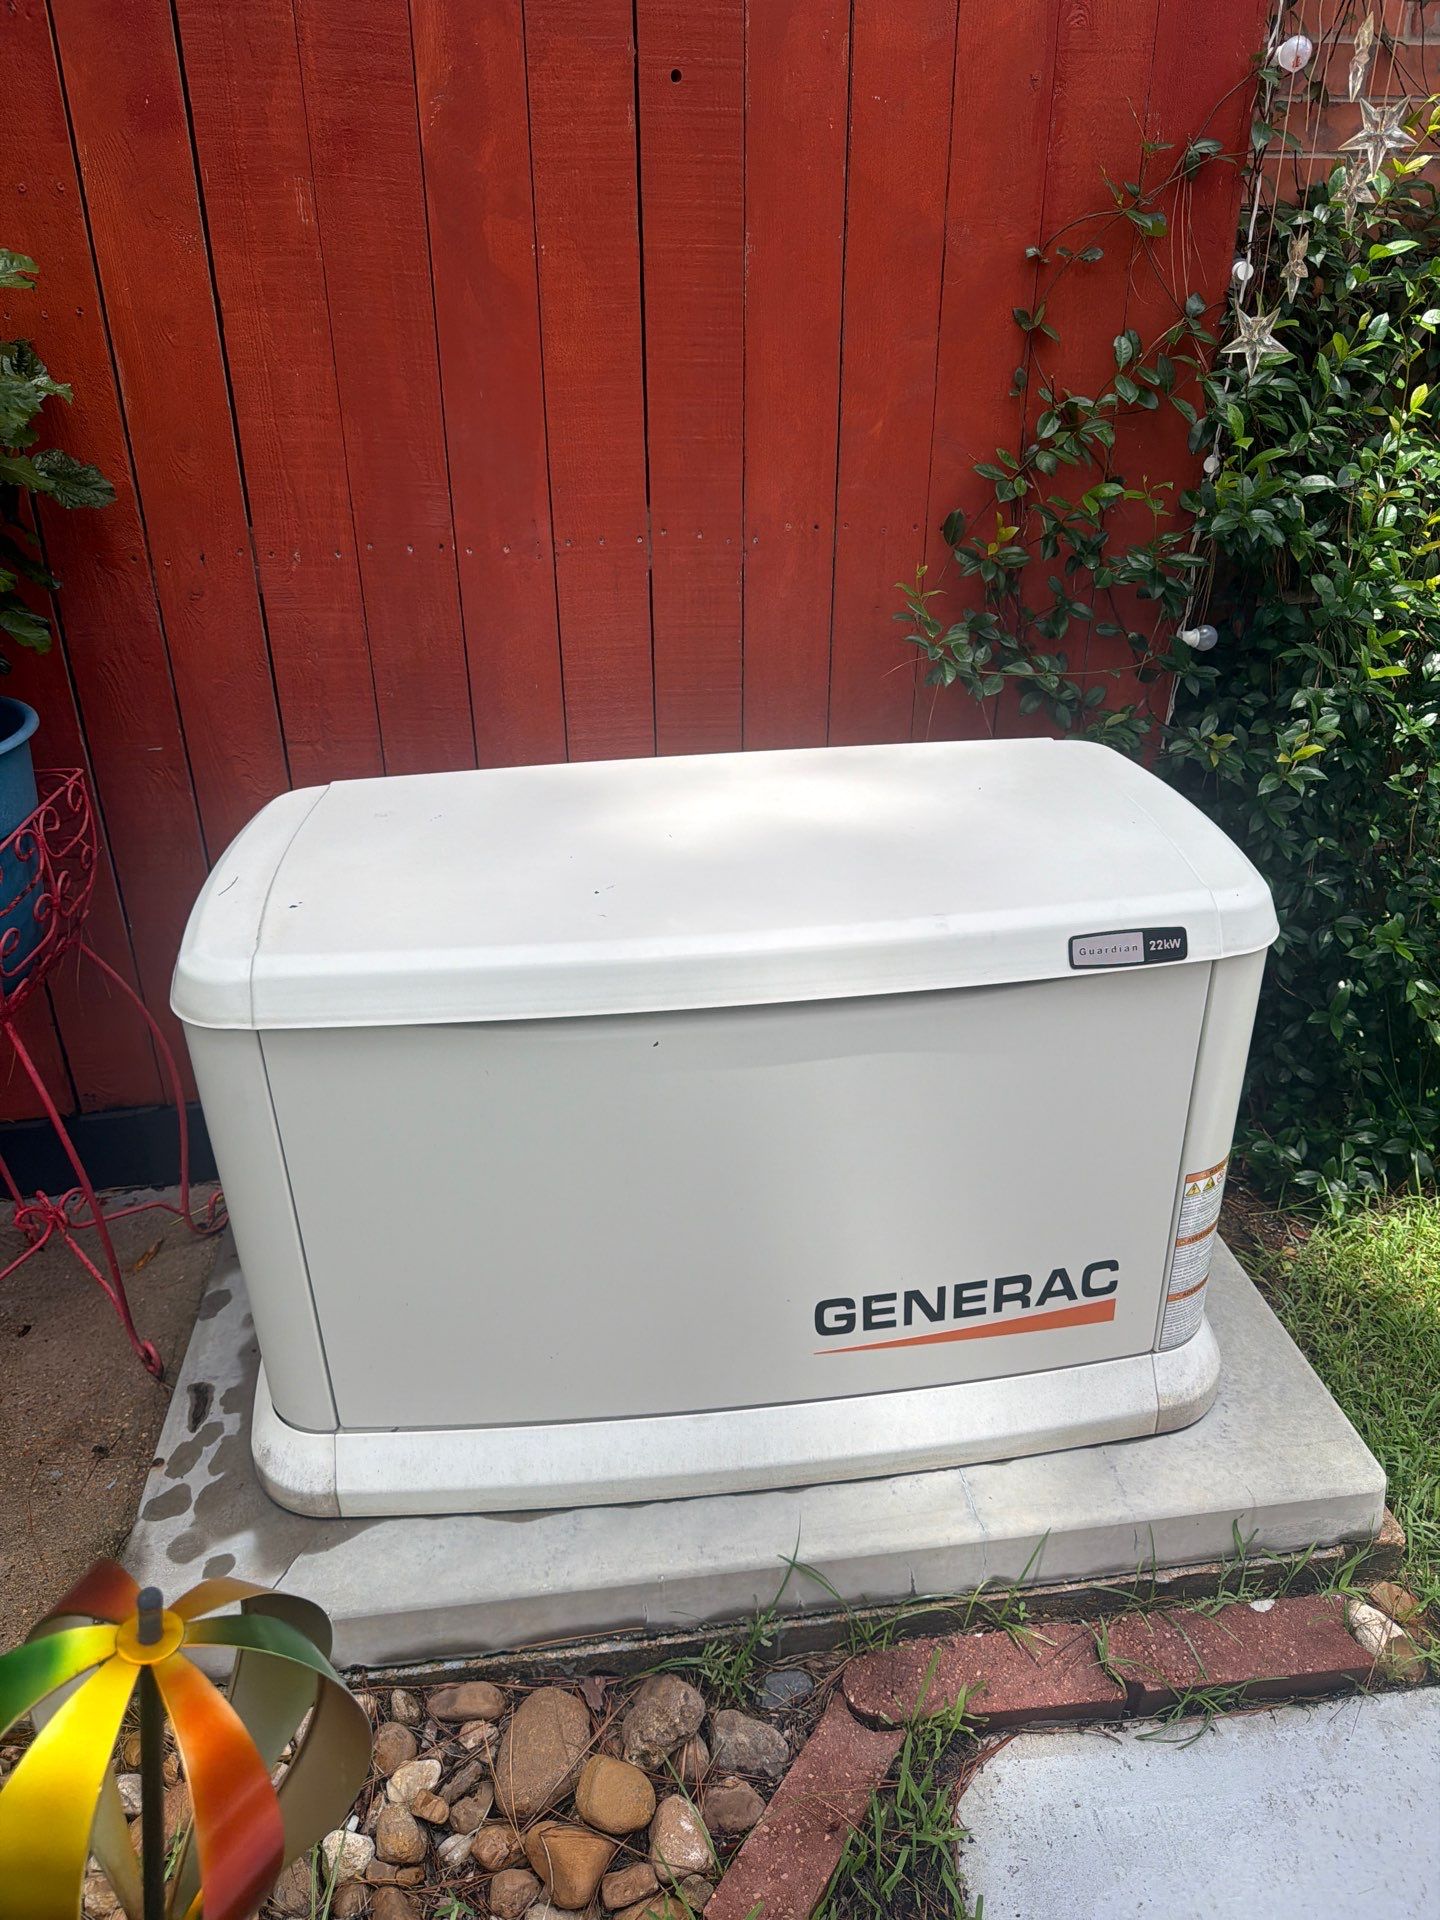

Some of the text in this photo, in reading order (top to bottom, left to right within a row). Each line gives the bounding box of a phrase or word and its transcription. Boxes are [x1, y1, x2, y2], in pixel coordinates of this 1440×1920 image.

[1079, 938, 1181, 956] Guardian 22kW
[814, 1259, 1119, 1336] GENERAC
